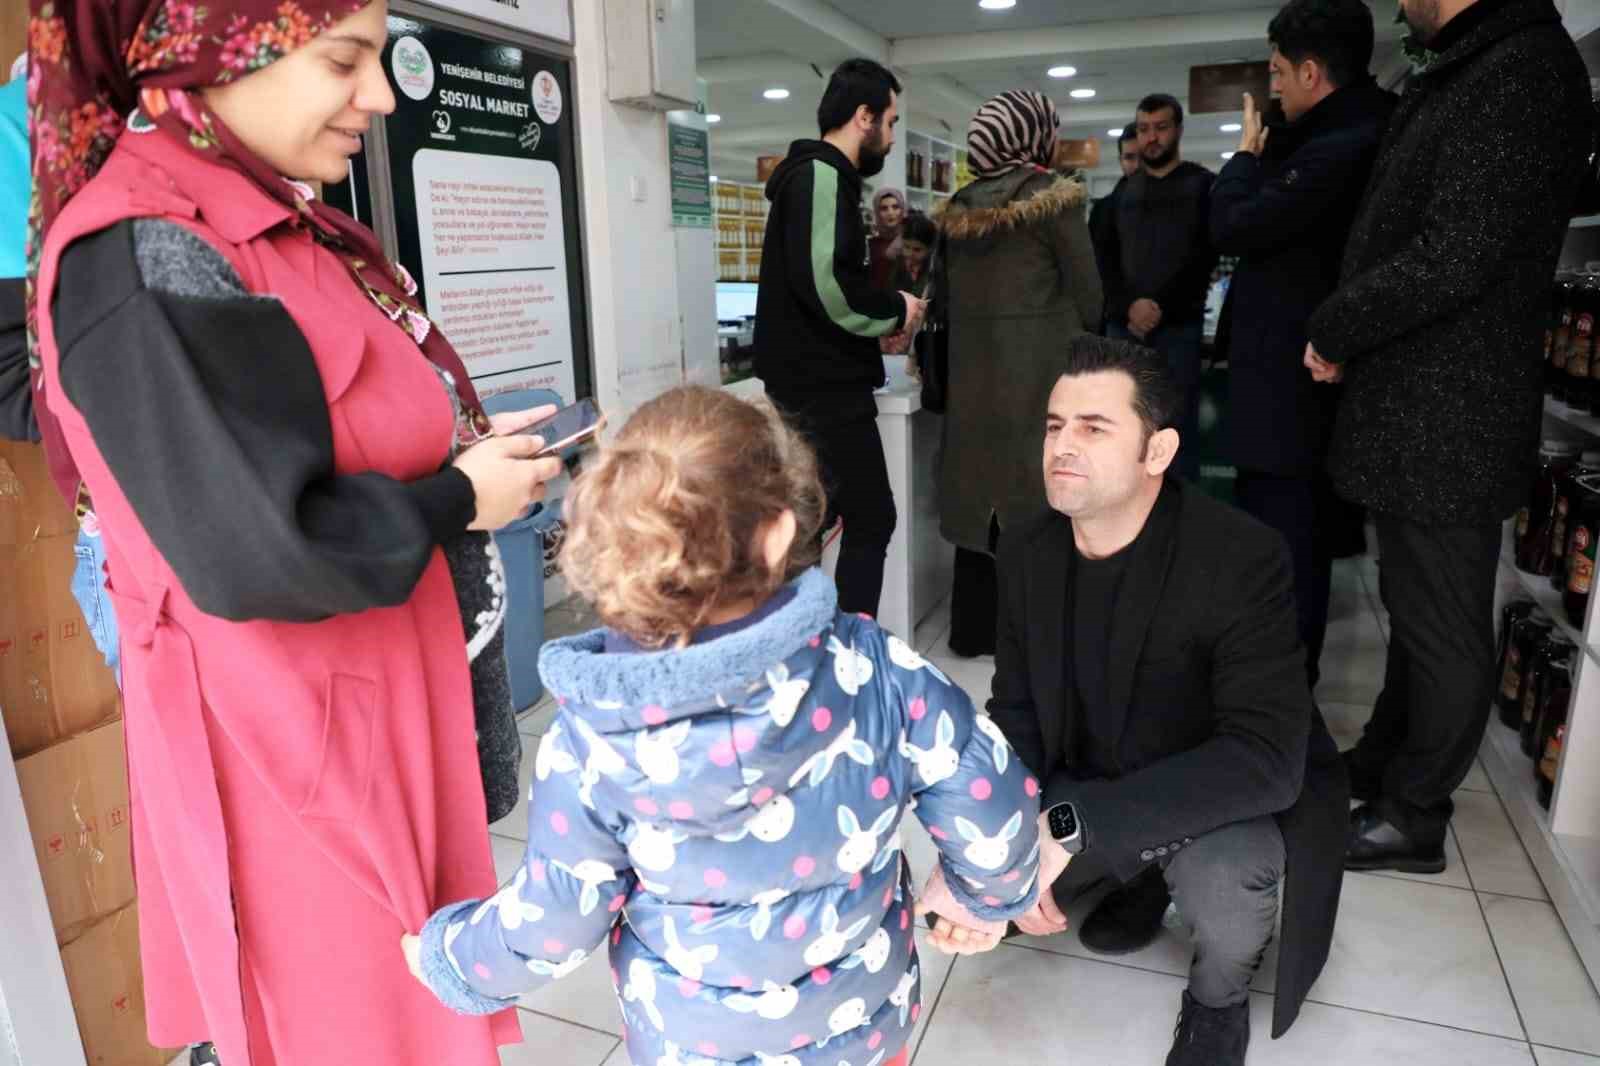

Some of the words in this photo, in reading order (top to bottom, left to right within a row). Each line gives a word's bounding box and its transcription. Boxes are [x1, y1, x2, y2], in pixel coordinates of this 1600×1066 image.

[440, 62, 483, 80] YENİŞEHİR
[484, 72, 525, 89] BELEDİYESİ
[439, 89, 485, 112] SOSYAL
[486, 97, 529, 118] MARKET
